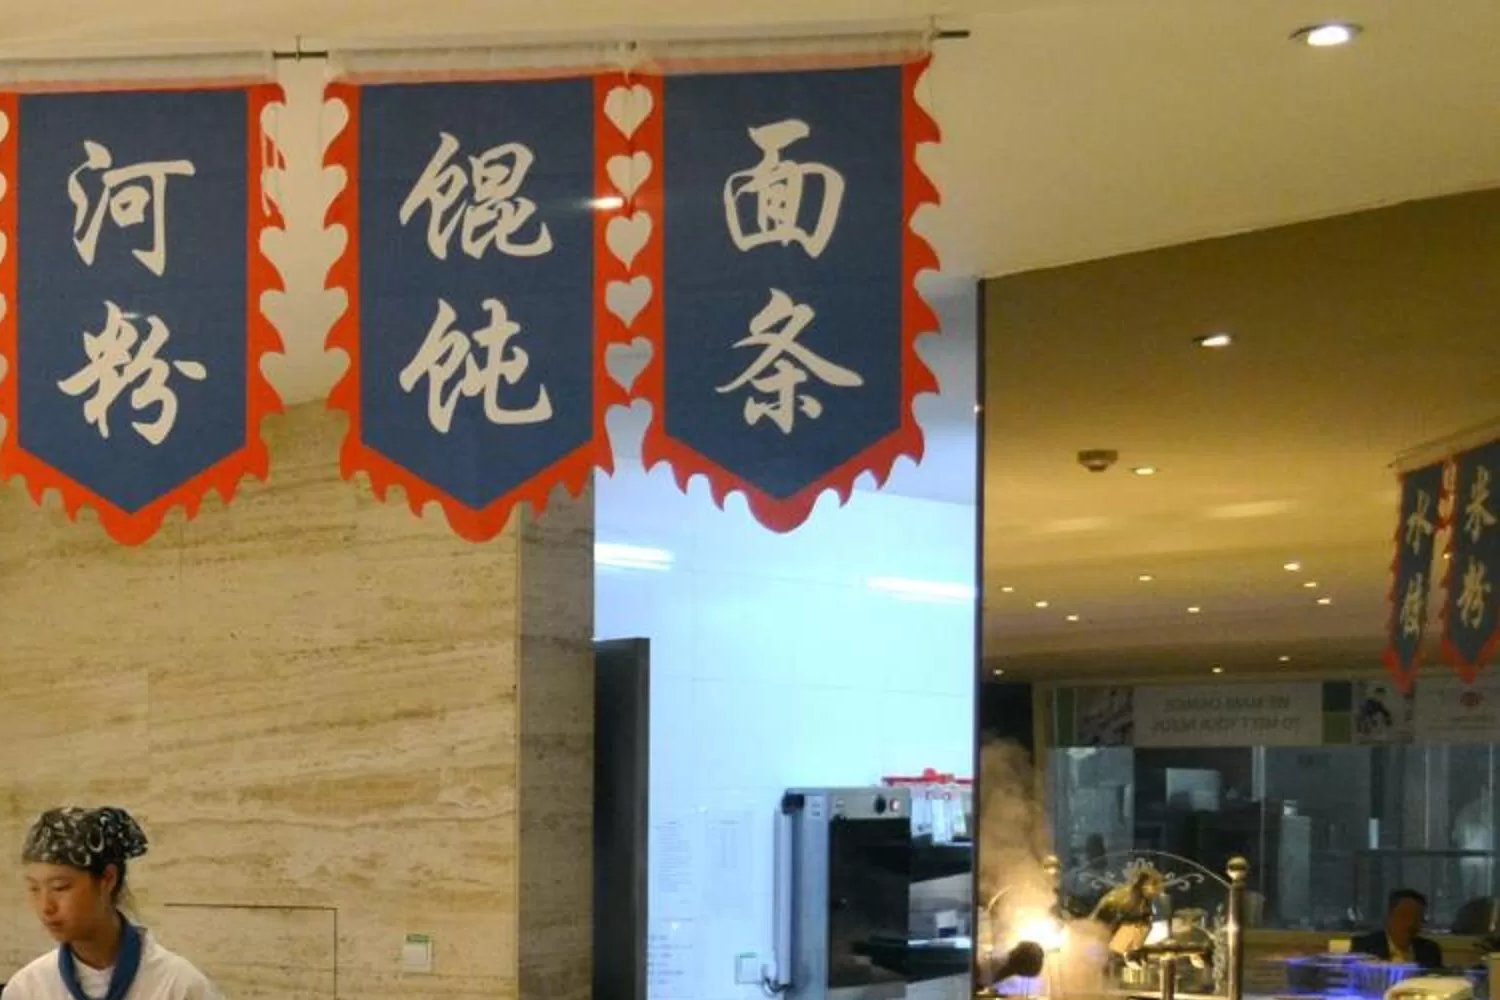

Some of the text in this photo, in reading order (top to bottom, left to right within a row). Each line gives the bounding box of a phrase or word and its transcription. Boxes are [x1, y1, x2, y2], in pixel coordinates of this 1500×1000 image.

[57, 140, 207, 445] 河粉
[399, 132, 553, 433] 馄饨
[716, 119, 863, 434] 面条
